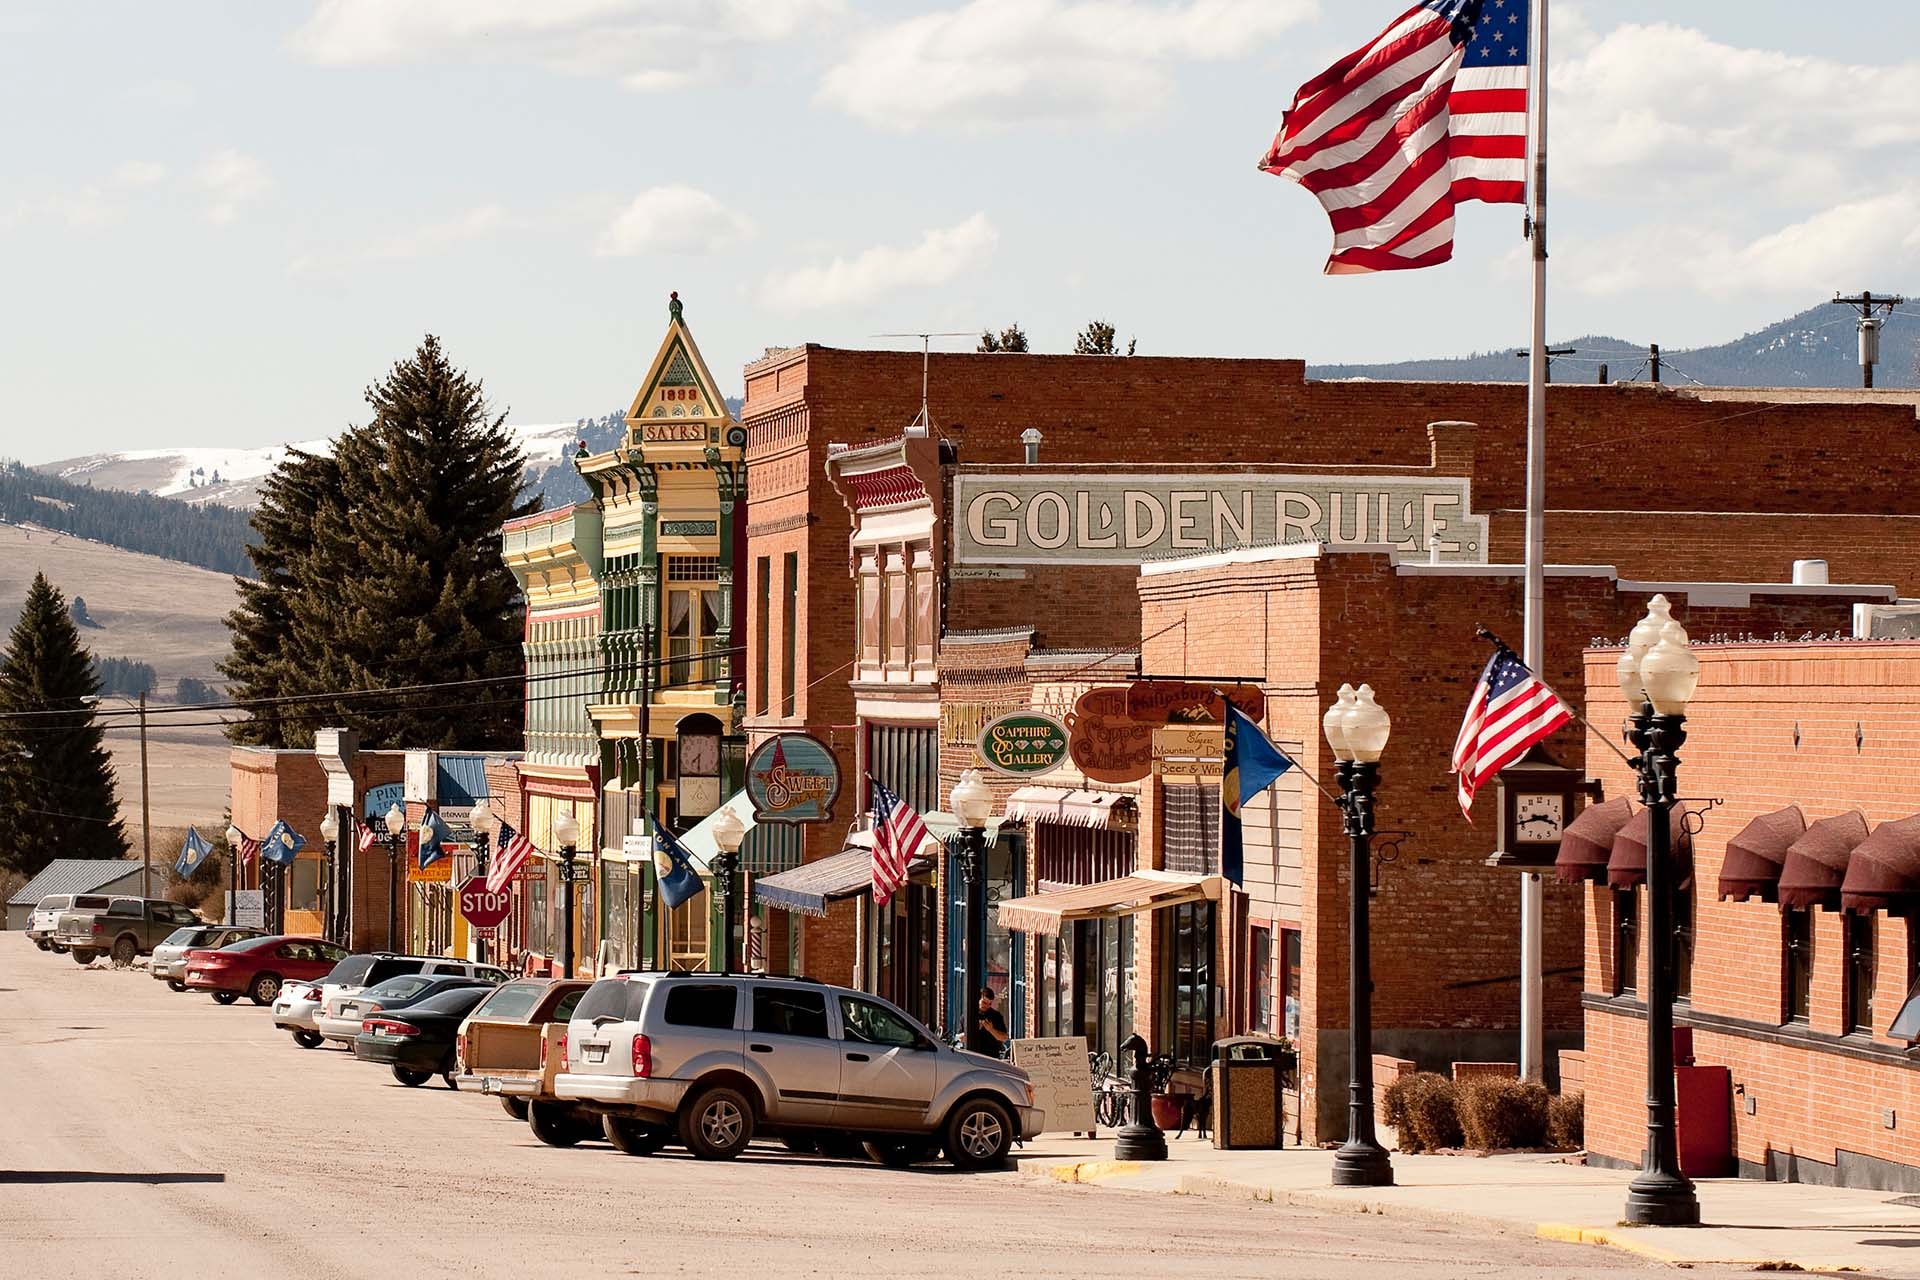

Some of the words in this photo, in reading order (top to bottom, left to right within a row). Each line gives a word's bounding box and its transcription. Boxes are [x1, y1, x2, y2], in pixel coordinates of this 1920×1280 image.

[661, 389, 697, 401] 1888
[646, 425, 700, 440] SAYRS
[966, 490, 1254, 550] GOLDEN
[1095, 694, 1126, 718] Th
[992, 725, 1051, 749] SAPPHIRE
[1153, 744, 1195, 756] Mountain
[1205, 745, 1224, 757] Din
[997, 752, 1054, 766] GALLERY
[1160, 763, 1187, 774] Beer
[1189, 765, 1198, 774] &
[1201, 764, 1222, 775] Win
[376, 786, 405, 801] PINT
[766, 764, 833, 809] SWEET
[463, 893, 508, 913] STOP
